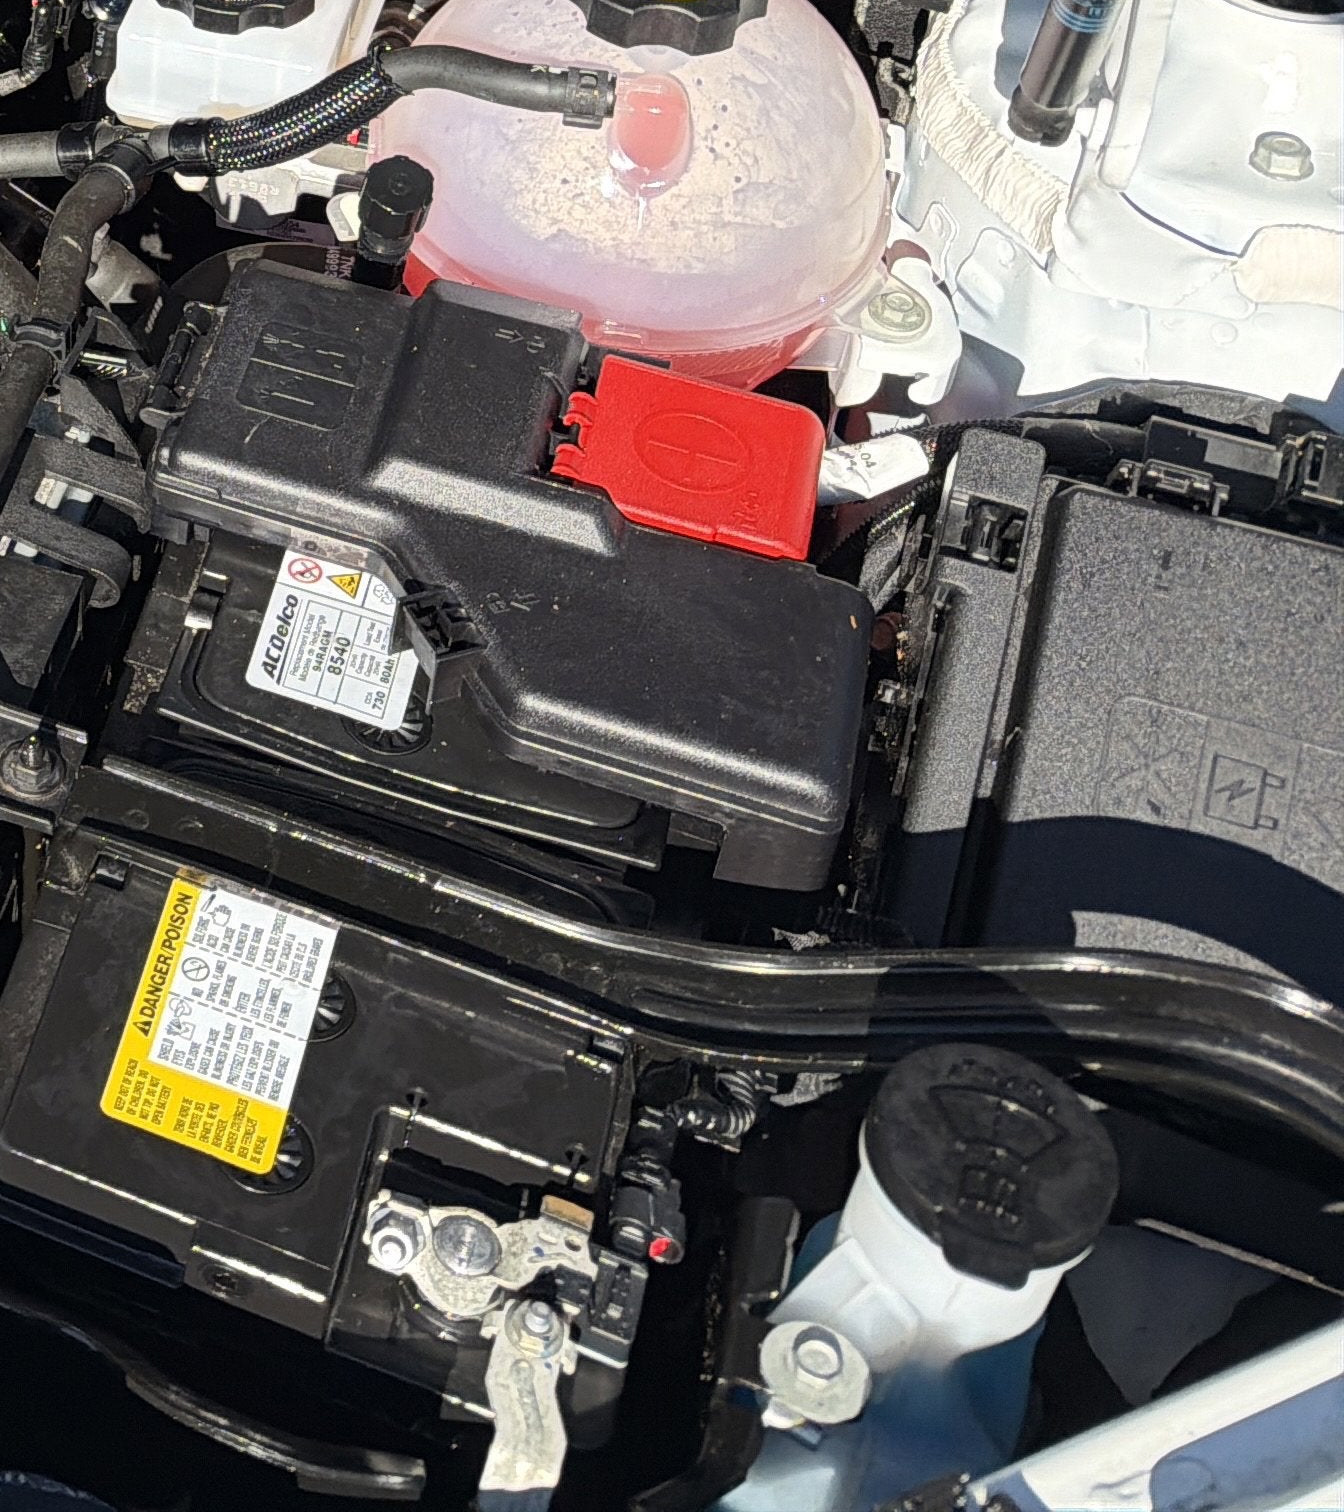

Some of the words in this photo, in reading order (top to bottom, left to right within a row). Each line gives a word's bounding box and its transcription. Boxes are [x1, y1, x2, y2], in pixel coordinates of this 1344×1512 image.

[260, 593, 299, 680] ACDelco
[301, 612, 315, 634] Model
[311, 629, 333, 673] 94RAGM
[326, 634, 352, 676] 8540
[379, 657, 396, 684] 80Ah
[371, 690, 386, 711] 730
[140, 891, 194, 1017] DANGER/POISON
